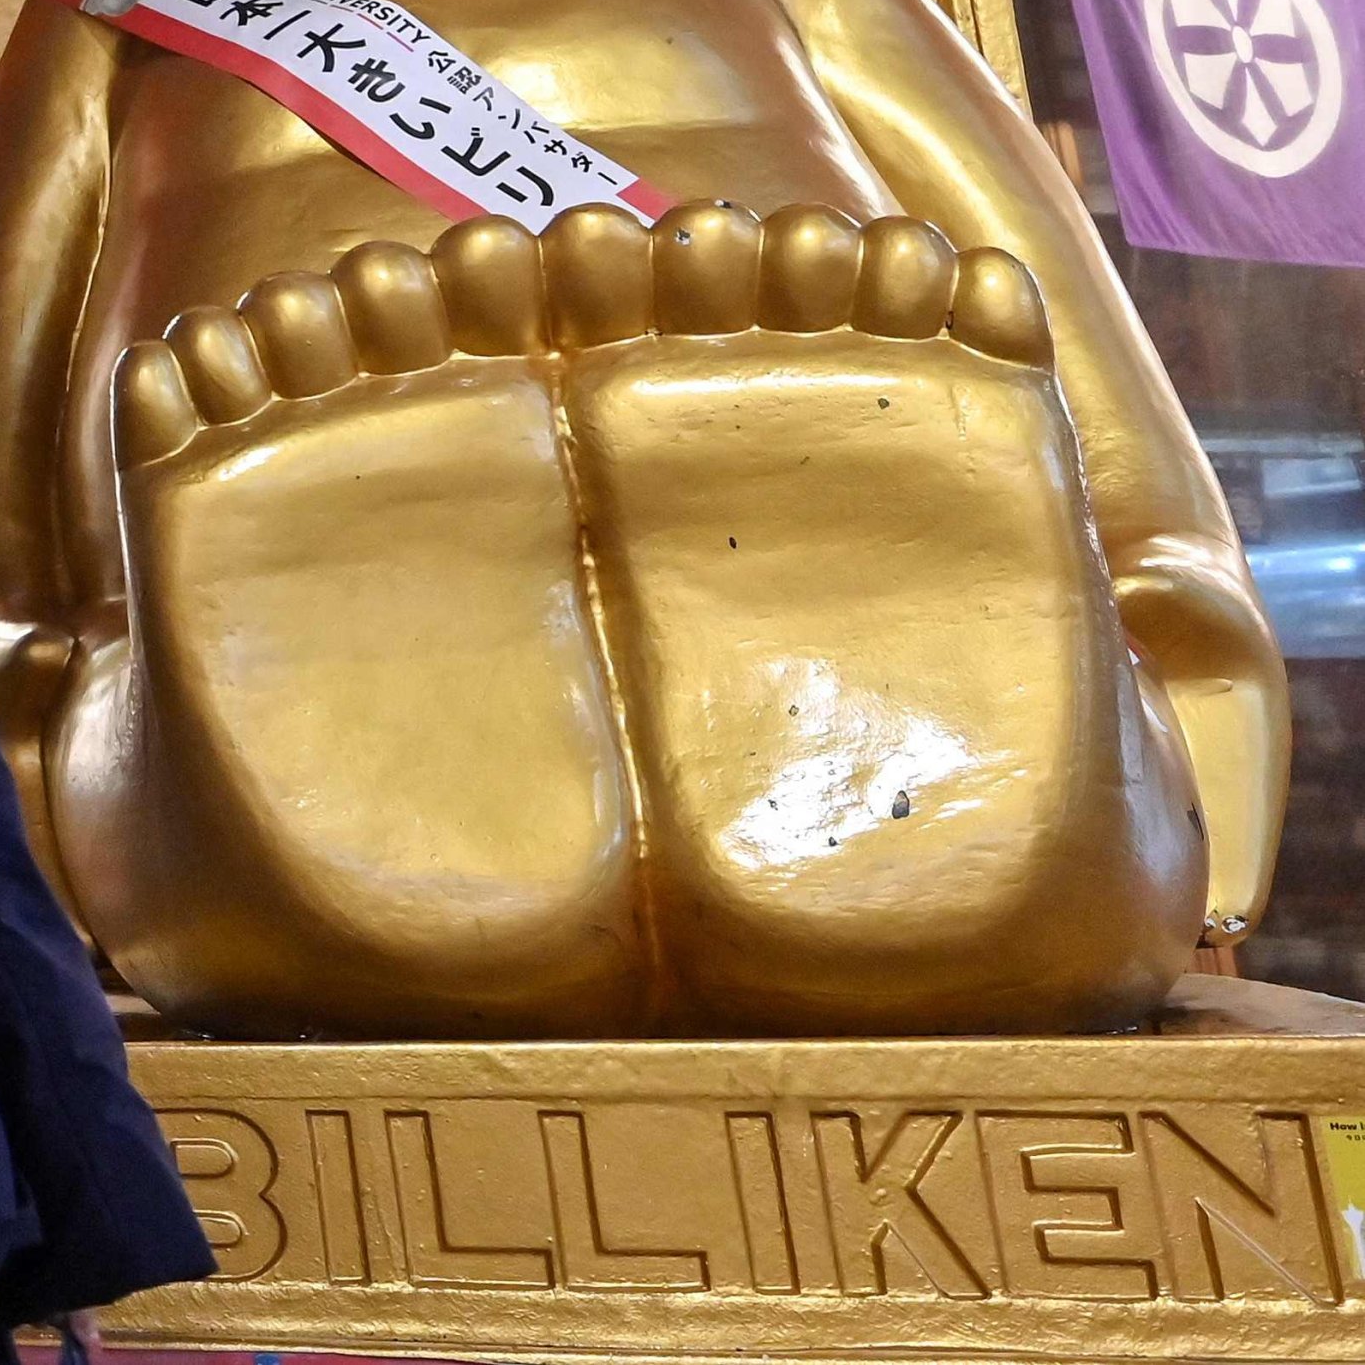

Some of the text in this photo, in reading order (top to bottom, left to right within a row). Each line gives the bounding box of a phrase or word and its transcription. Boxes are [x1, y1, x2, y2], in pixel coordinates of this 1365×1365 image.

[427, 49, 619, 186] 公認アンバサダー
[155, 1107, 1342, 1307] BILLIKEN
